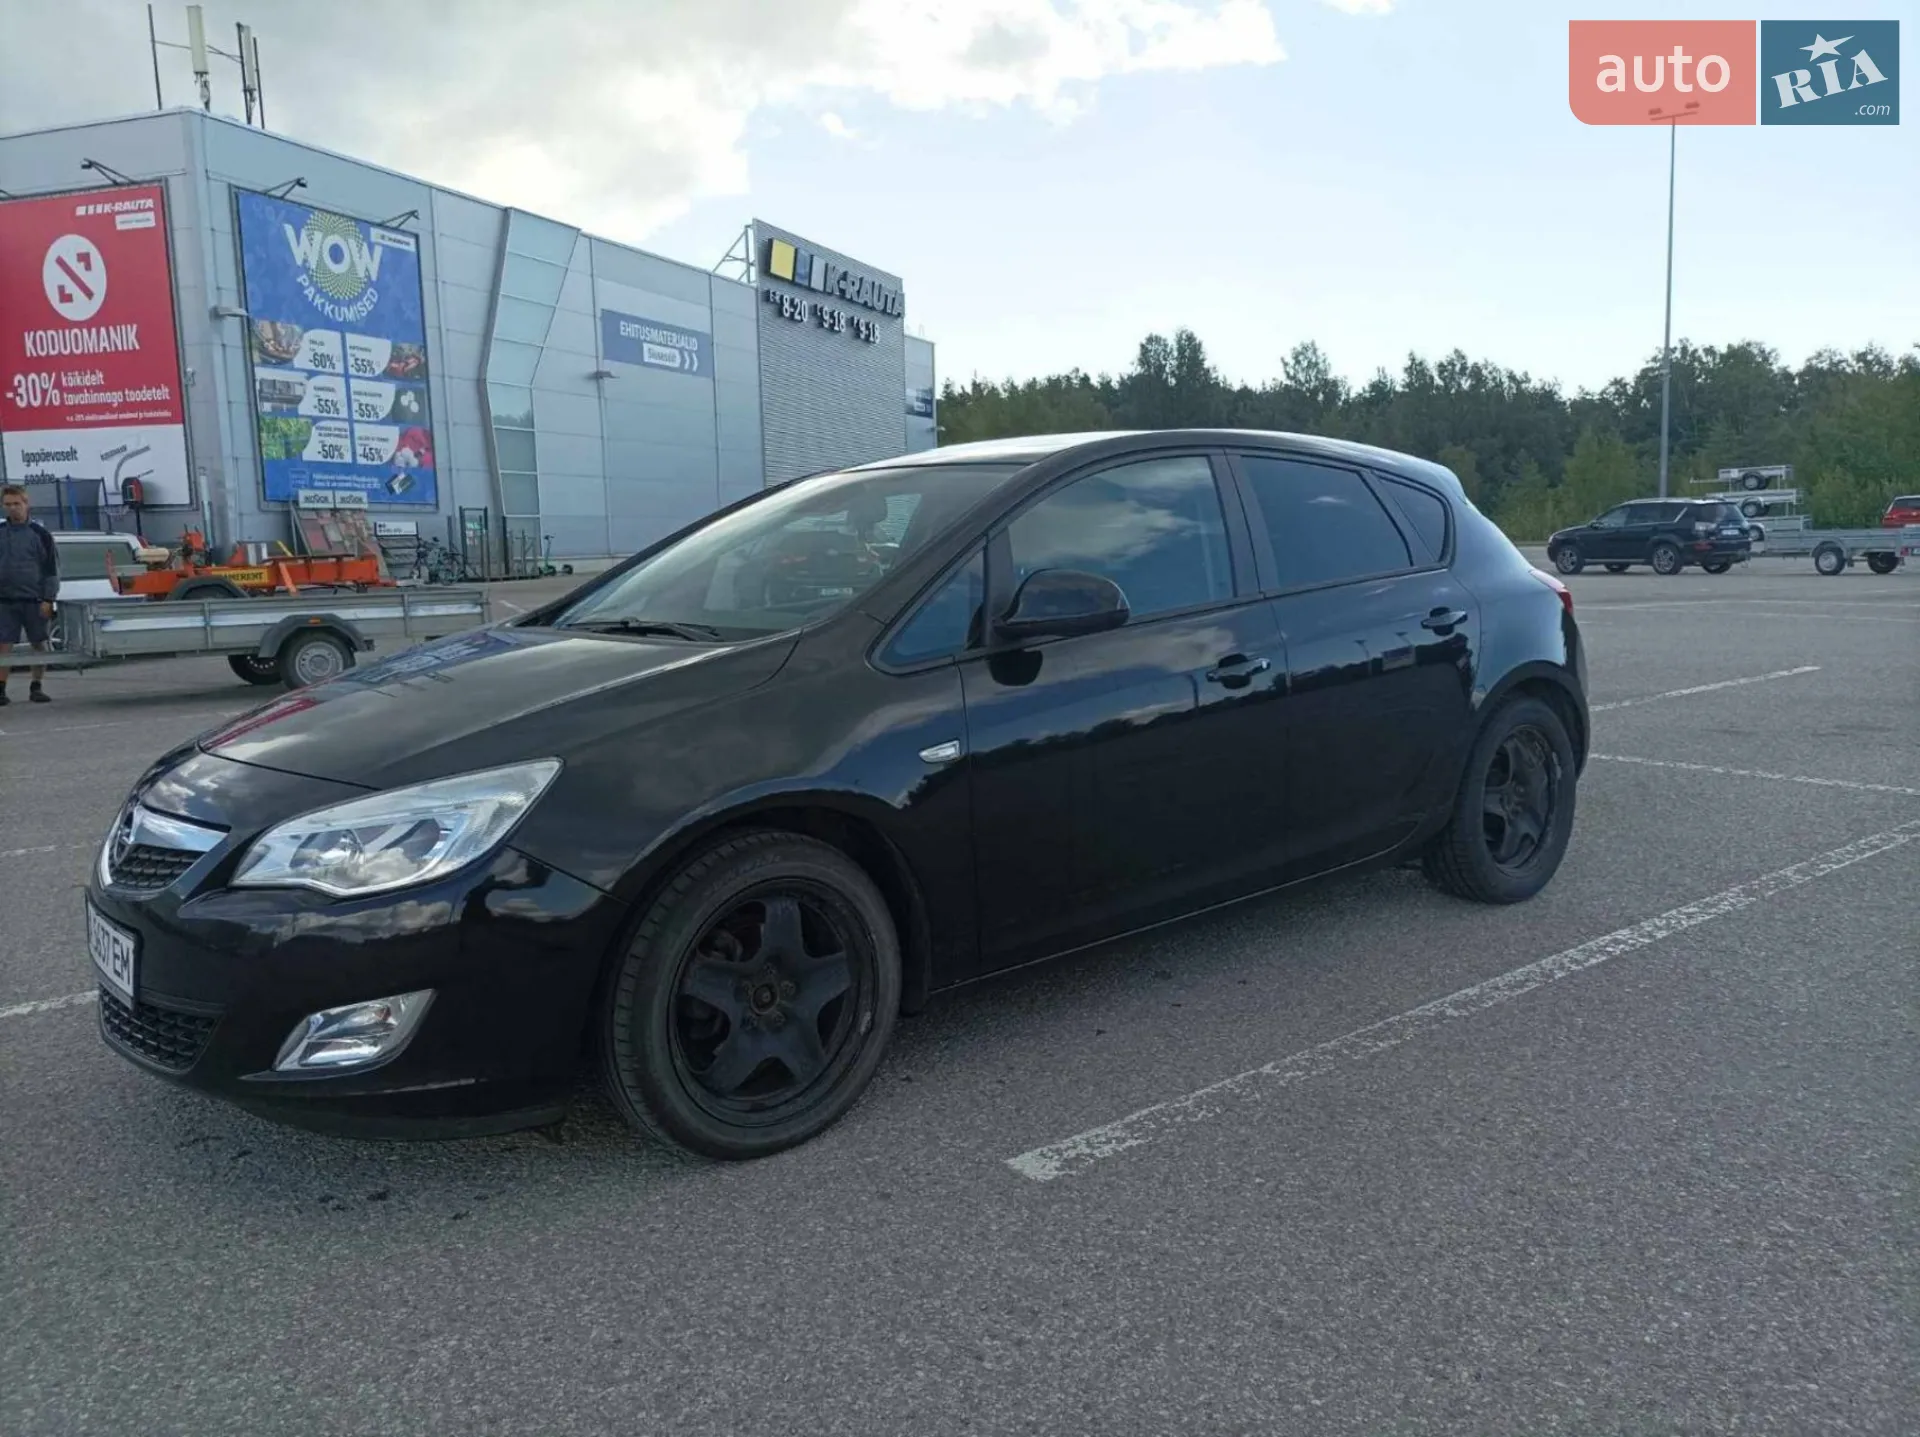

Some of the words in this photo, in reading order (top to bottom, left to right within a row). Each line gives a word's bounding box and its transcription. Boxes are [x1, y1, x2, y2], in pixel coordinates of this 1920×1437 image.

[104, 199, 155, 213] K-RAUTA
[284, 223, 383, 281] WOW
[296, 273, 378, 322] PAKKUMISED
[826, 263, 905, 316] K-RAUTA
[783, 295, 808, 323] 8-20
[822, 306, 846, 333] 9-18
[859, 319, 881, 344] 9-18
[24, 324, 140, 358] KODUOMANIK
[308, 352, 336, 370] -60%
[350, 358, 376, 375] -55%
[61, 369, 105, 387] kõikidelt
[6, 372, 61, 409] -30%
[64, 390, 124, 407] tavahinnaga
[125, 384, 170, 403] toodetelt
[313, 398, 341, 415] -55%
[354, 402, 380, 419] -55%
[21, 445, 79, 467] Igapäevaselt
[317, 443, 345, 460] -50%
[359, 446, 383, 463] -45%
[112, 934, 131, 985] EM
